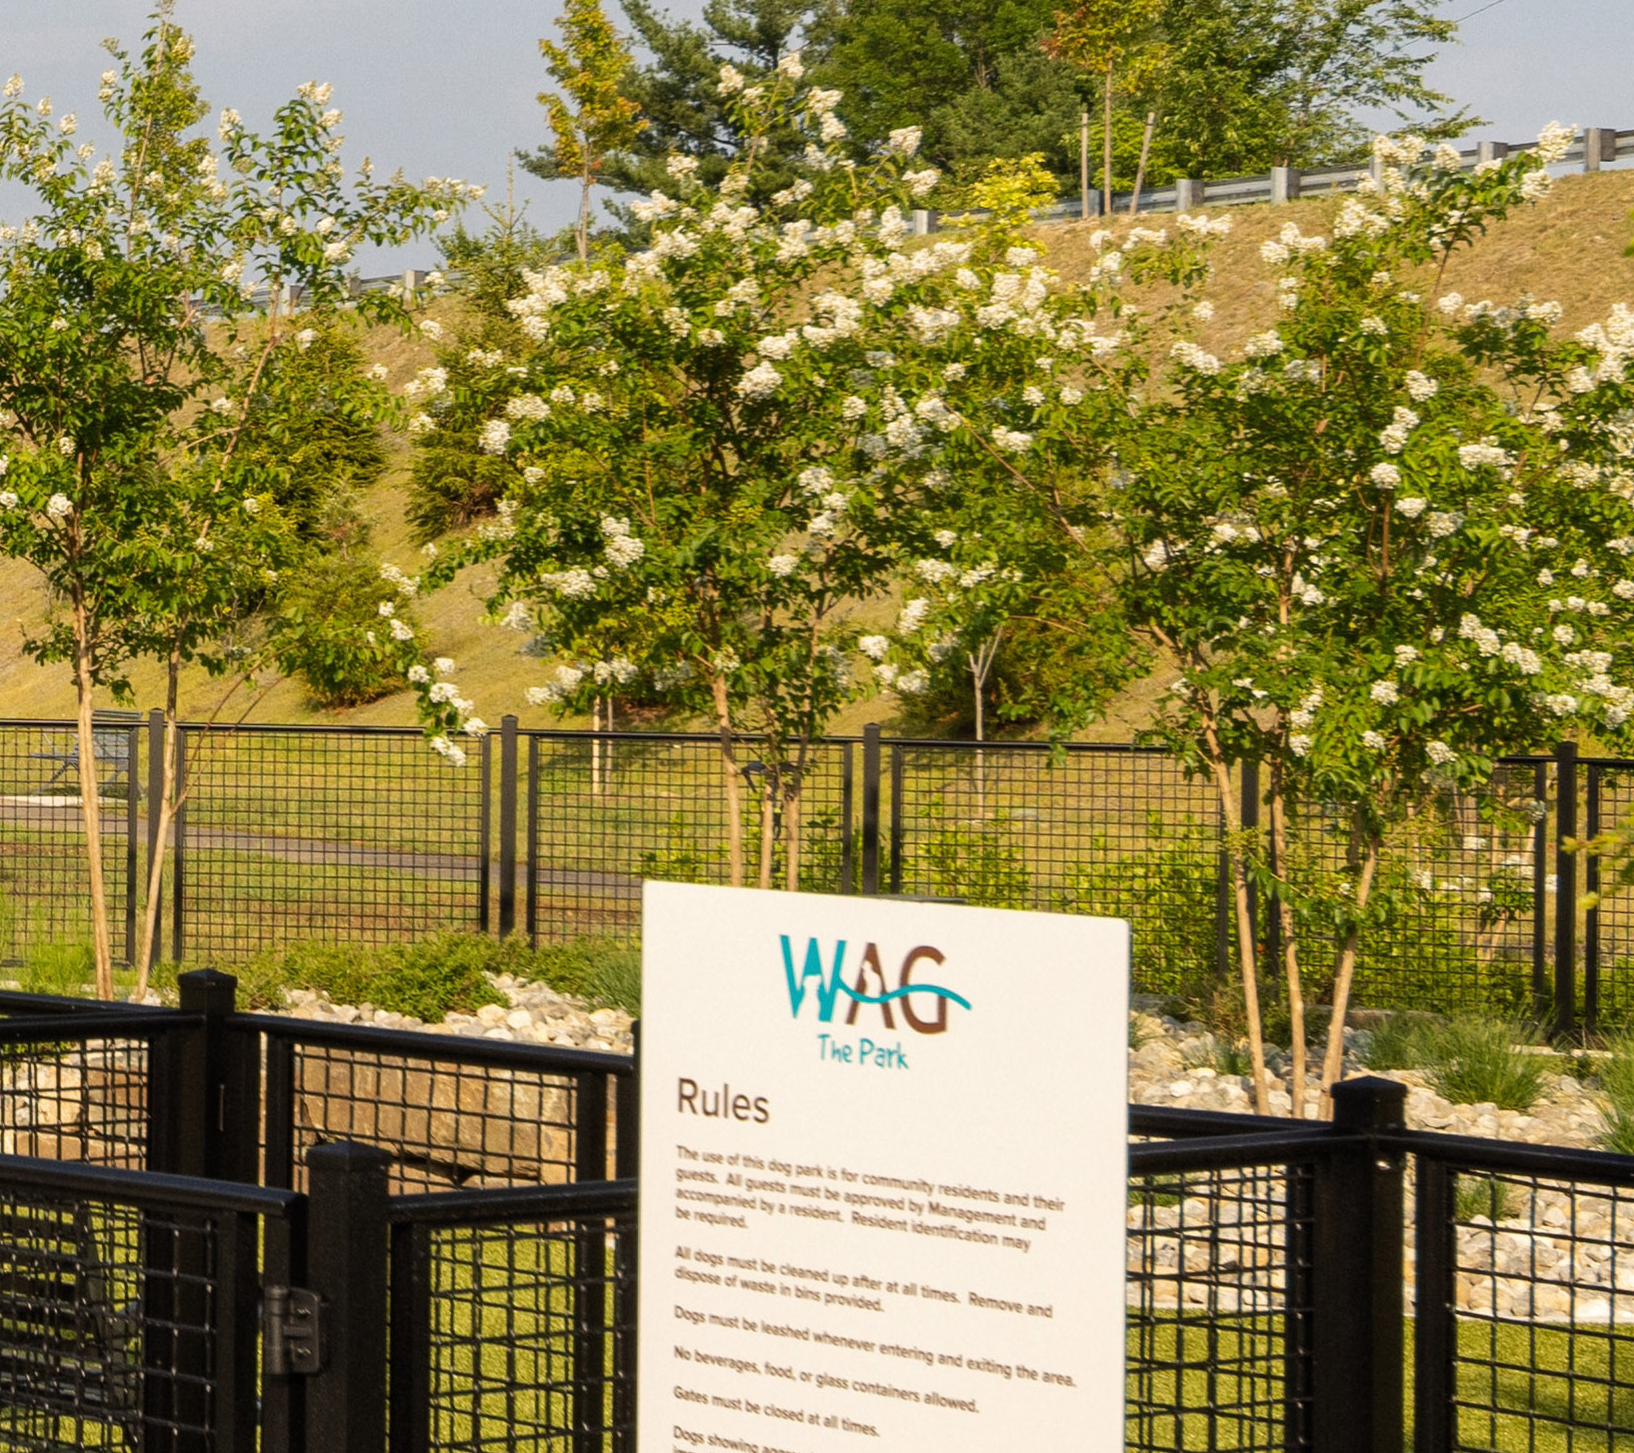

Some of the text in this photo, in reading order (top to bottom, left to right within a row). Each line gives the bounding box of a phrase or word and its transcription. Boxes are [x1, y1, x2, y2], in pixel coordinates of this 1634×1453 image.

[779, 934, 972, 1035] WAG
[817, 1033, 909, 1070] The Park
[676, 1077, 770, 1124] Rules
[675, 1144, 1066, 1212] The use of this dog park is for community residents and their
[675, 1167, 1046, 1231] guests. All guests must be approved by Management and
[675, 1205, 749, 1229] be required.
[675, 1188, 1031, 1254] accompanied by a resident. Resident identification may
[674, 1245, 1053, 1319] All dogs must be cleaned up after at all times. Remove and
[674, 1266, 885, 1312] dispose of waste in bins provided.
[673, 1304, 1077, 1388] Dogs must be leashed whenever entering and exiting the area.
[672, 1385, 880, 1437] Gates must be closed at all times.
[673, 1344, 980, 1414] No beverages, food, or glass containers allowed.
[672, 1424, 706, 1447] Dogs
